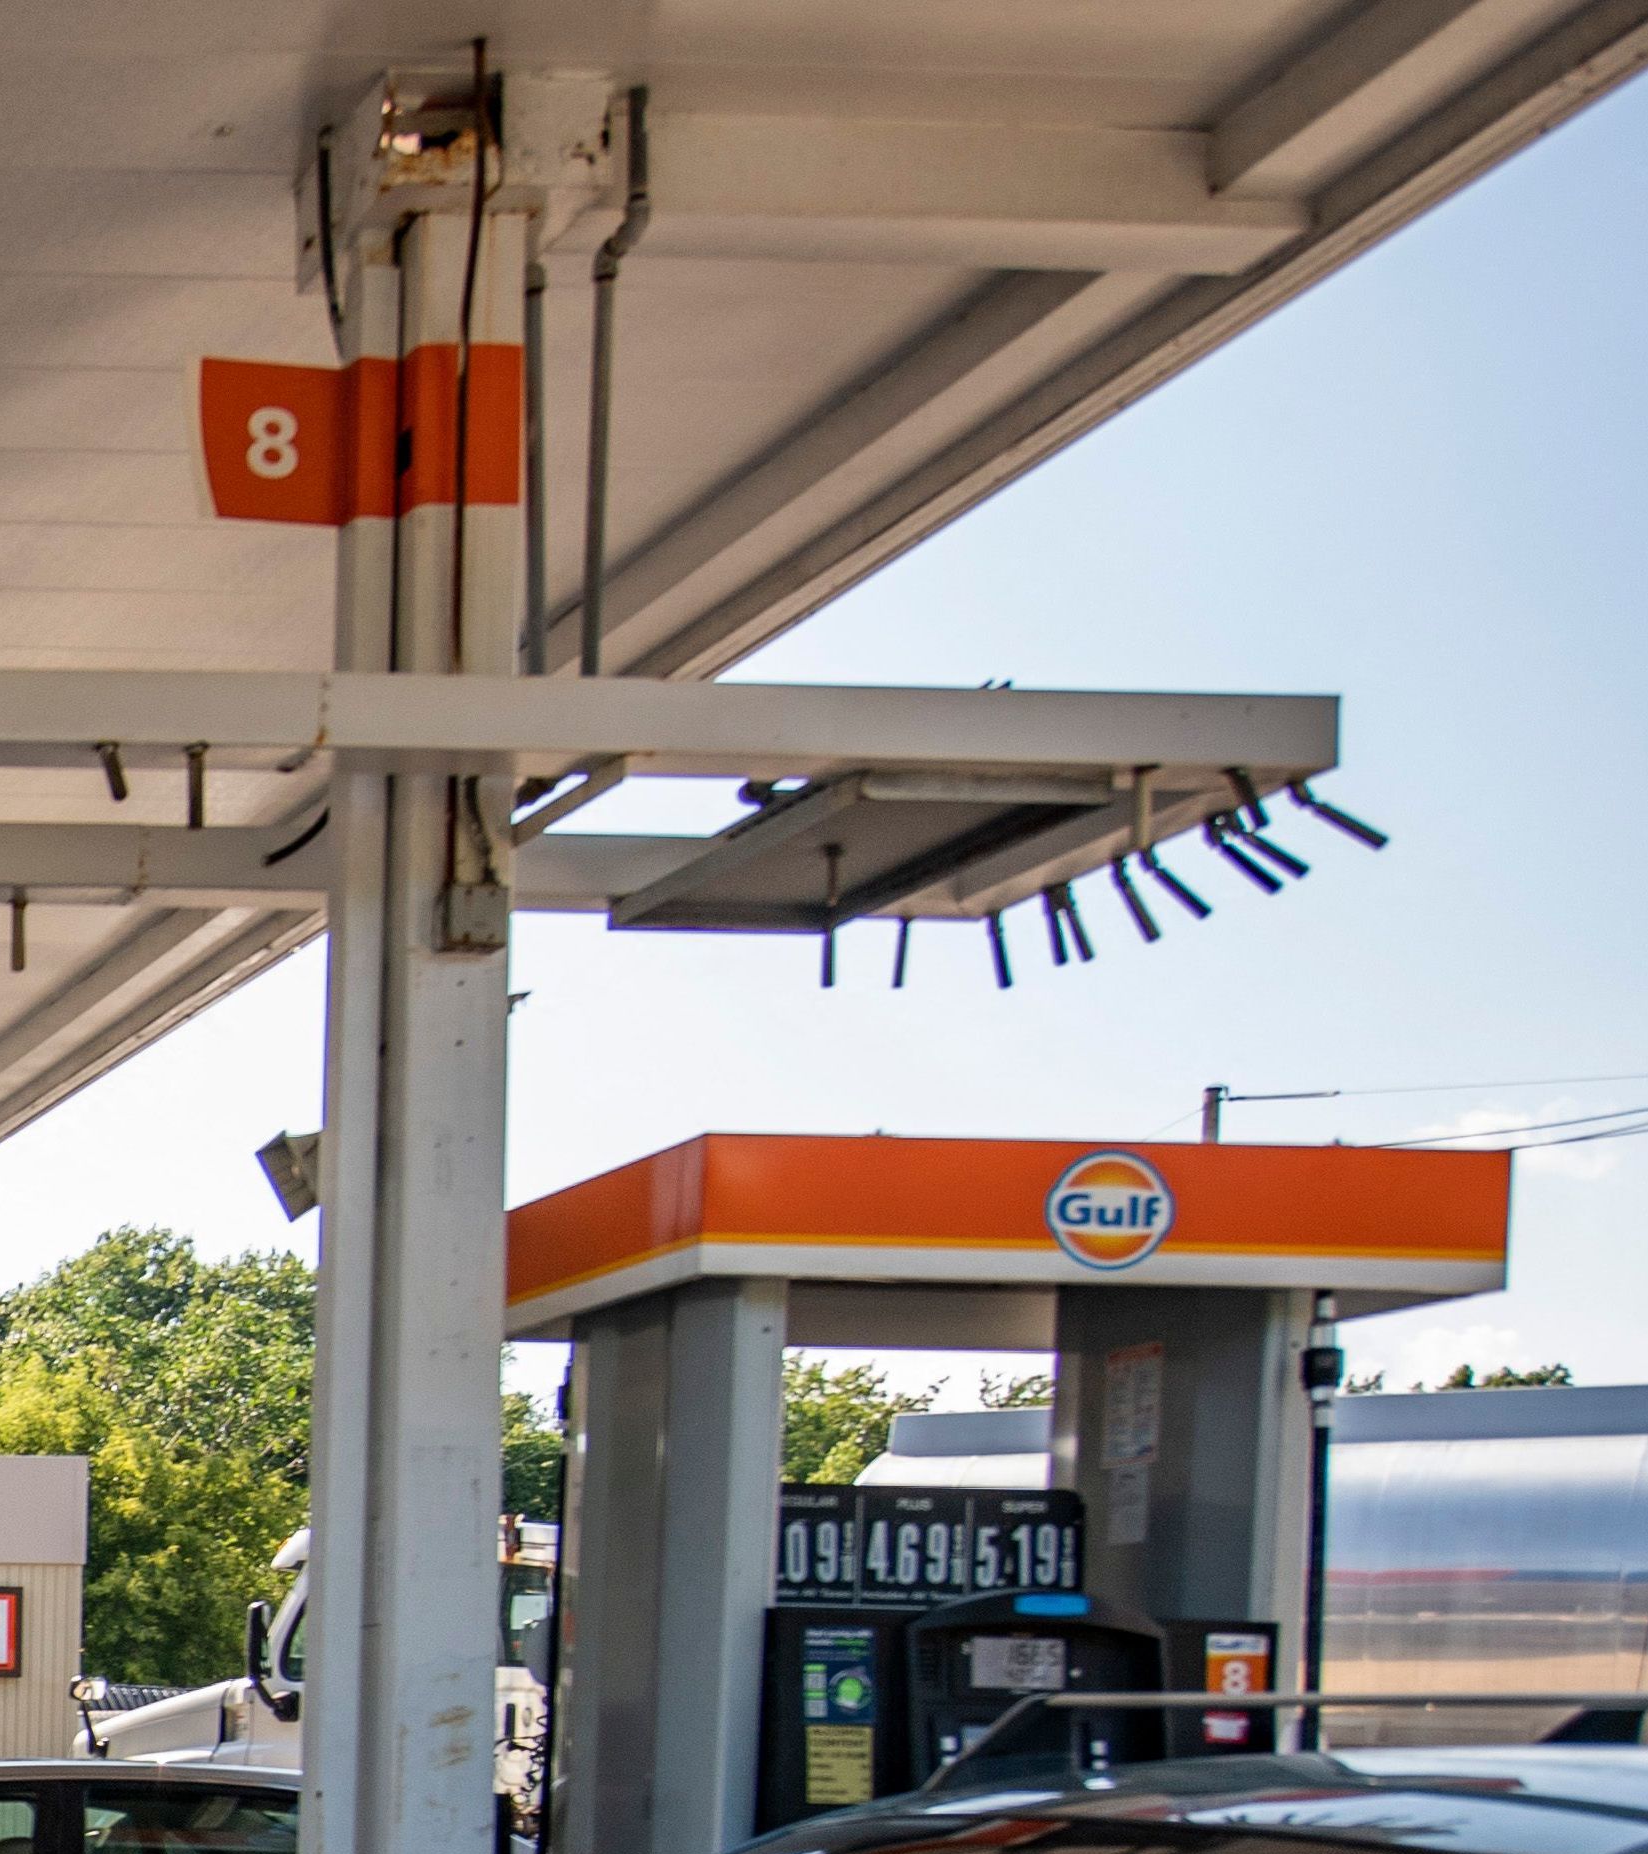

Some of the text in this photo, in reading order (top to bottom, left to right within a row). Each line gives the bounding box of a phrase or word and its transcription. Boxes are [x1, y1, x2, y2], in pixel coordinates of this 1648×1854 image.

[245, 406, 300, 480] 8
[1057, 1192, 1163, 1228] Gulf
[1222, 1661, 1247, 1697] 8
